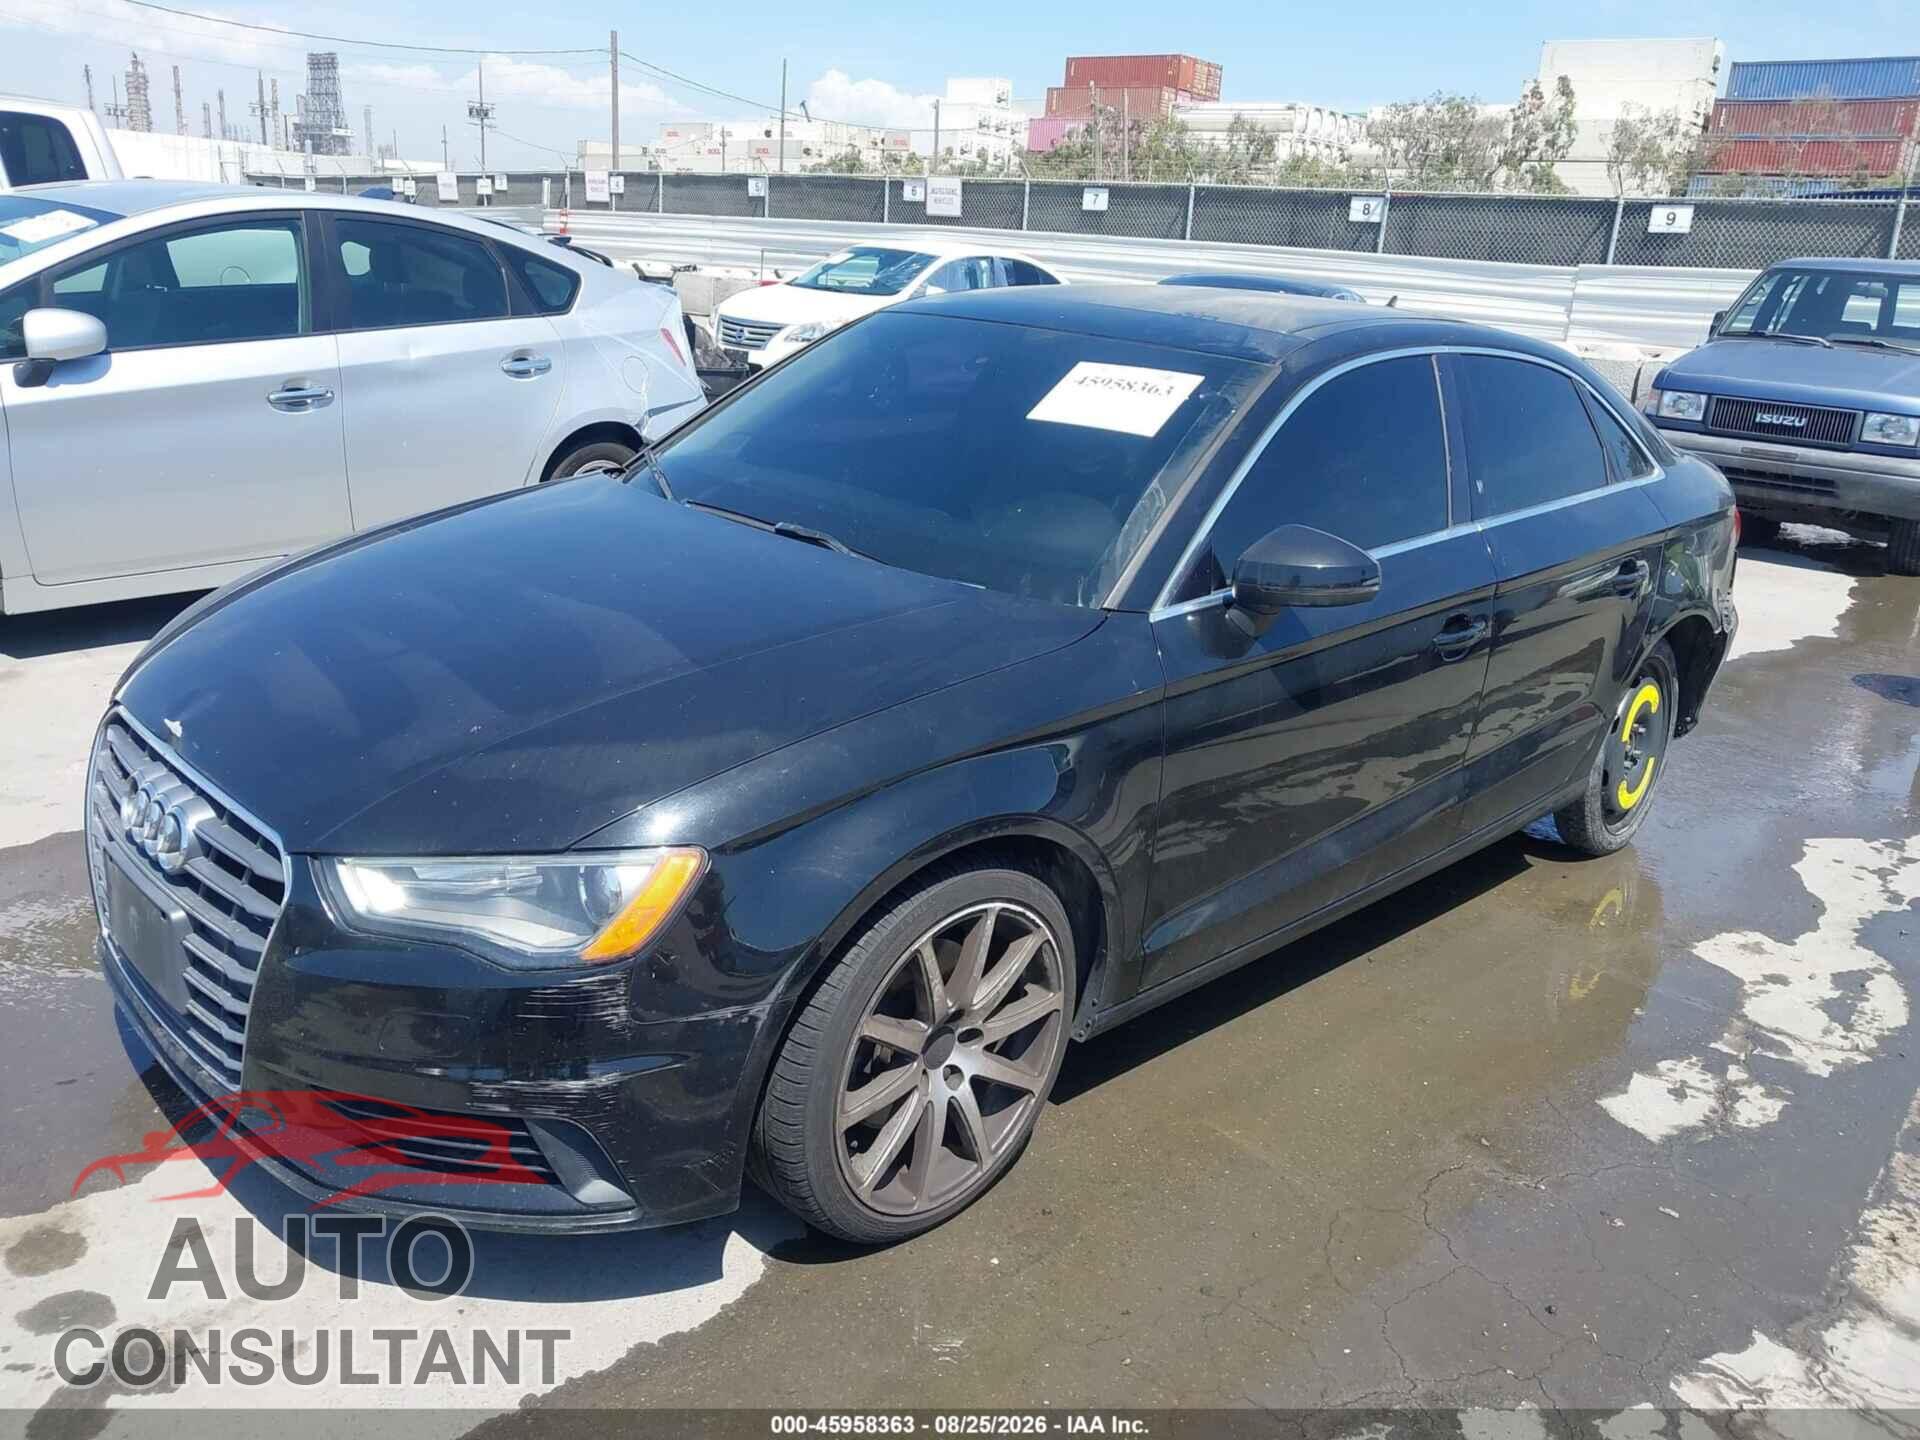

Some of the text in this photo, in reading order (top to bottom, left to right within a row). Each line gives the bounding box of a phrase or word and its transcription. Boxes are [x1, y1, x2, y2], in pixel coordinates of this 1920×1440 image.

[911, 185, 918, 197] 6
[1092, 193, 1100, 208] 7
[1362, 202, 1371, 216] 8
[1665, 211, 1677, 226] 9
[1755, 412, 1807, 427] ISUZU
